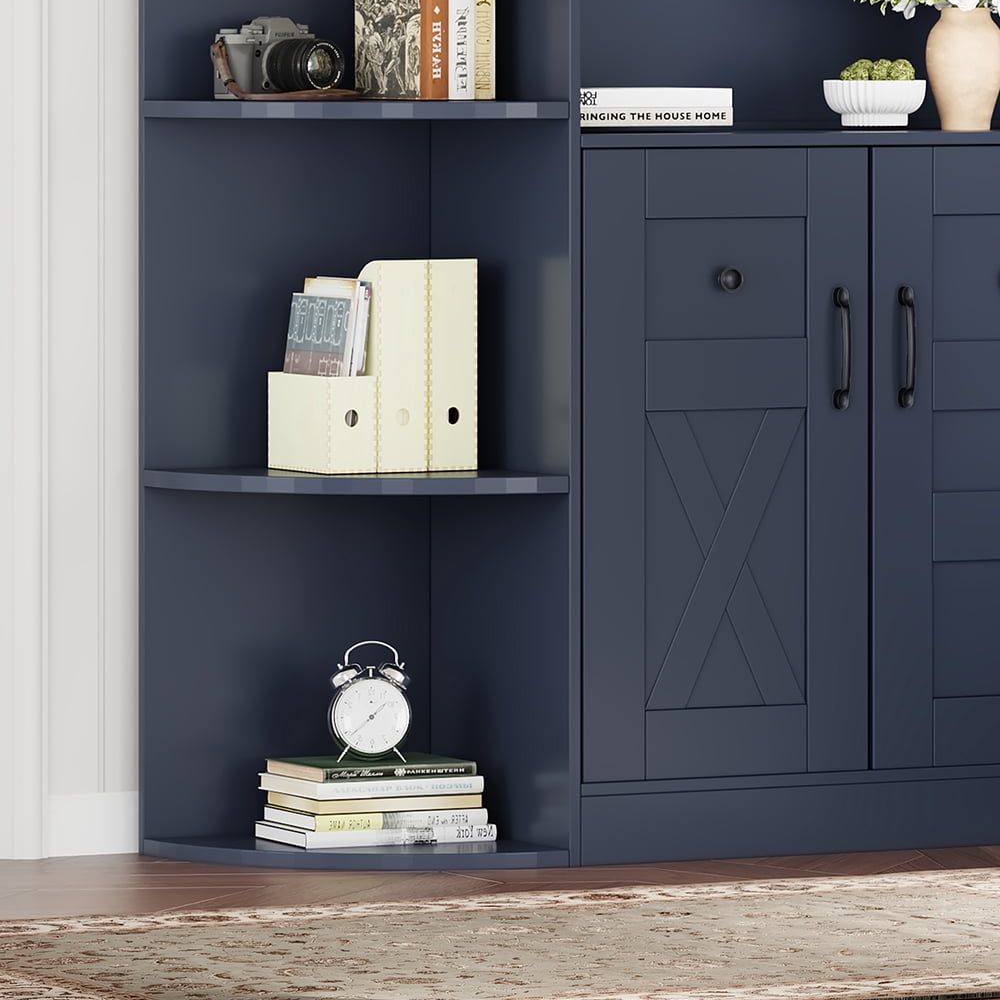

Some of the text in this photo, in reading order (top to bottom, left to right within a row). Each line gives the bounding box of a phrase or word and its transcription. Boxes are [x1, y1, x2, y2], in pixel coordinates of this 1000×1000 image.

[630, 112, 651, 121] THE
[655, 112, 691, 120] HOUSE
[695, 111, 727, 120] HOME
